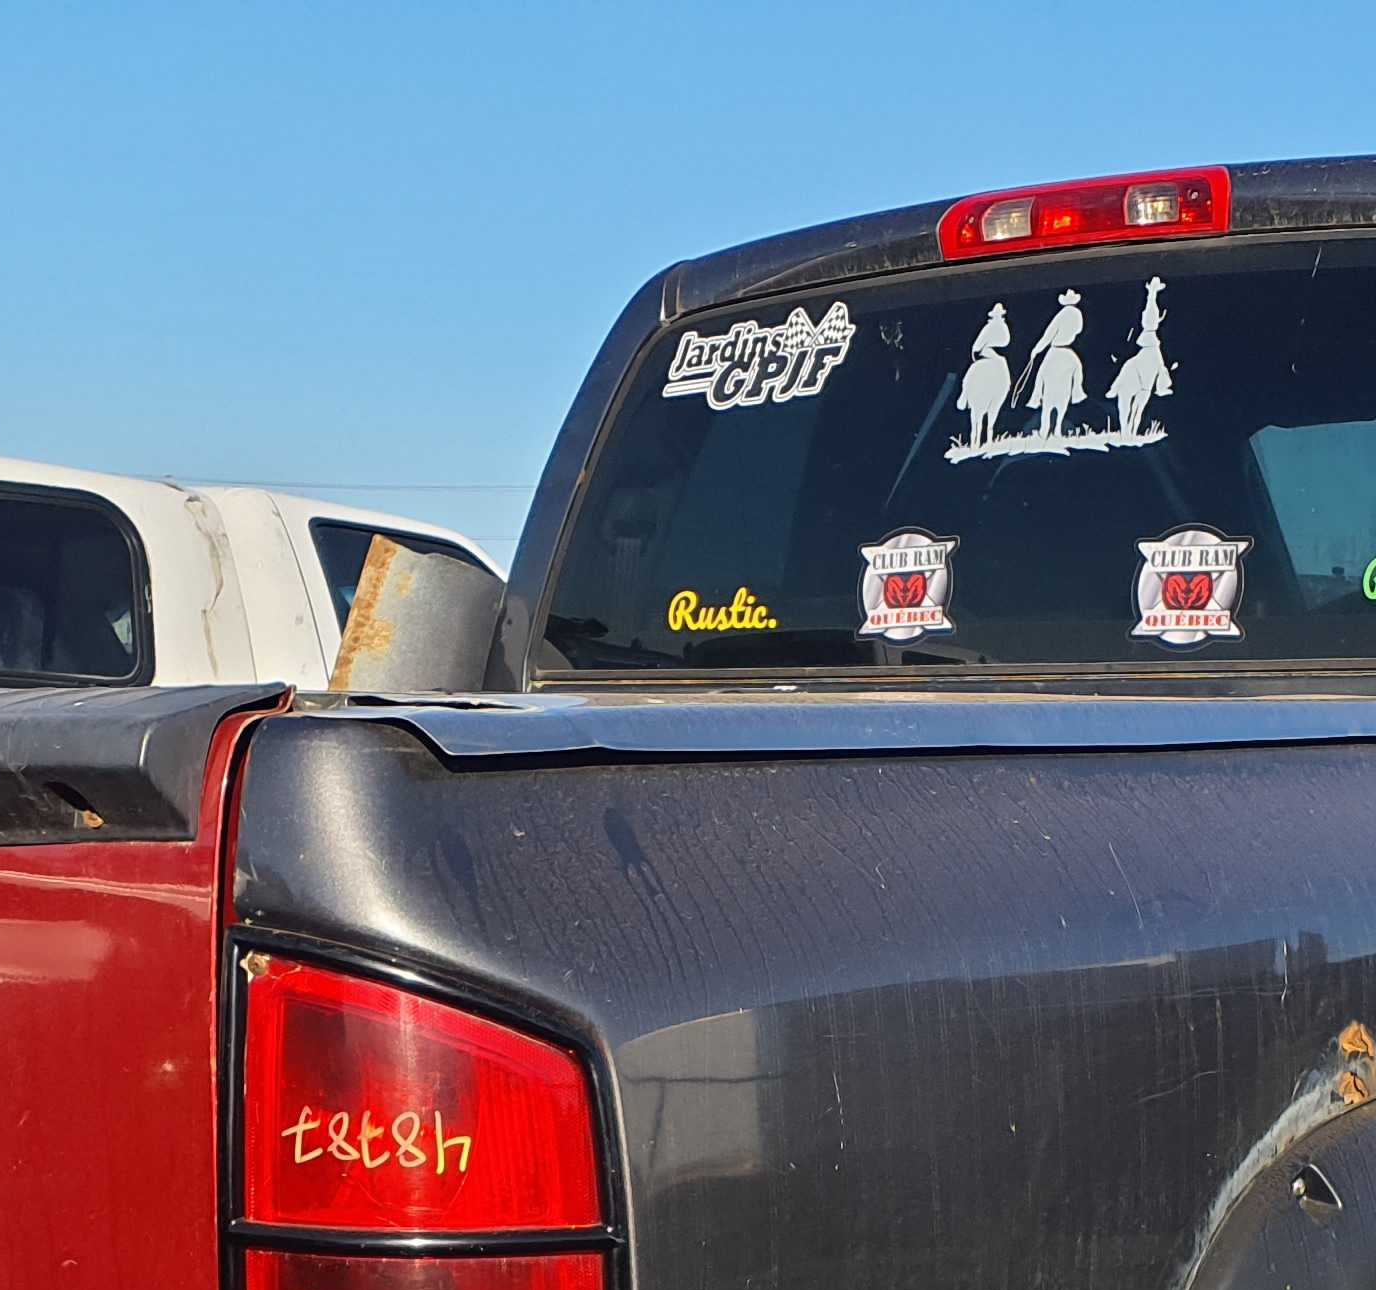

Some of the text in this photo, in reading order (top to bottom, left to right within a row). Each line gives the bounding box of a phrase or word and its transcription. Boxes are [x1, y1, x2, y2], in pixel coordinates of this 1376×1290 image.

[674, 323, 786, 375] Jardins
[872, 549, 945, 570] CLUB RAM
[1150, 548, 1235, 568] CLUB RAM
